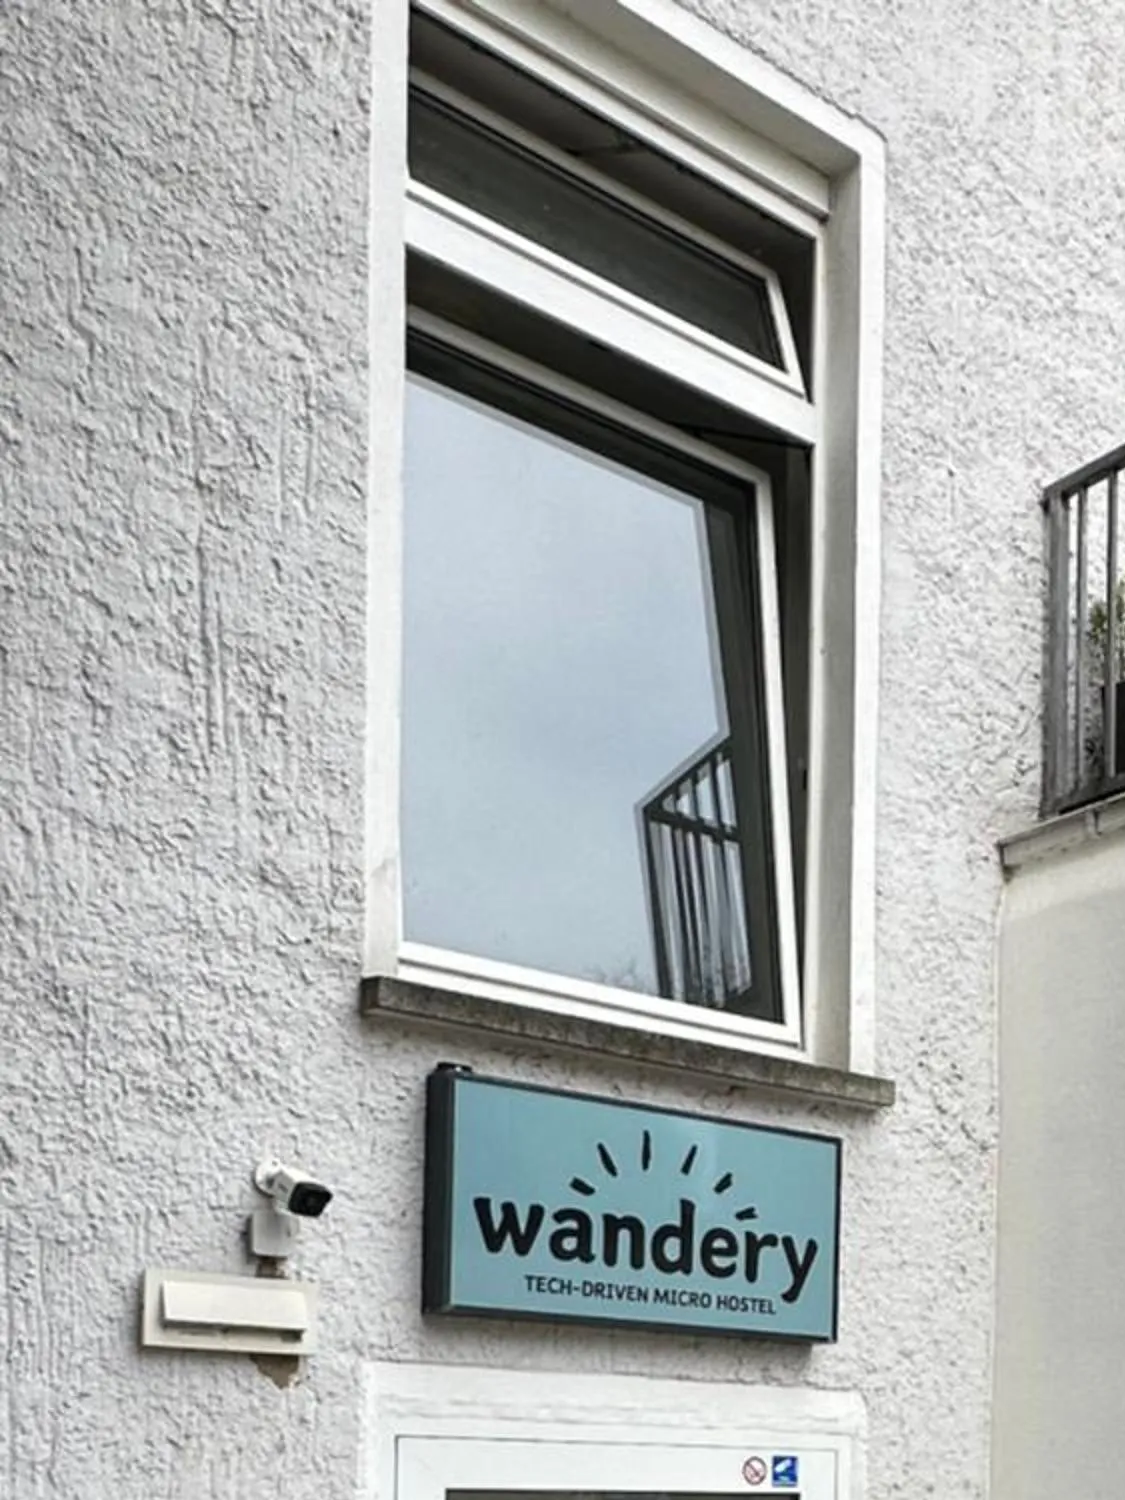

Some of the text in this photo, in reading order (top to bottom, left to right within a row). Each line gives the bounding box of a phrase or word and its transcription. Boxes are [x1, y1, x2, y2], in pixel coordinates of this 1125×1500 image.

[473, 1196, 818, 1303] wandery
[524, 1274, 776, 1315] TECH-DRIVEN MICRO HOSTEL
